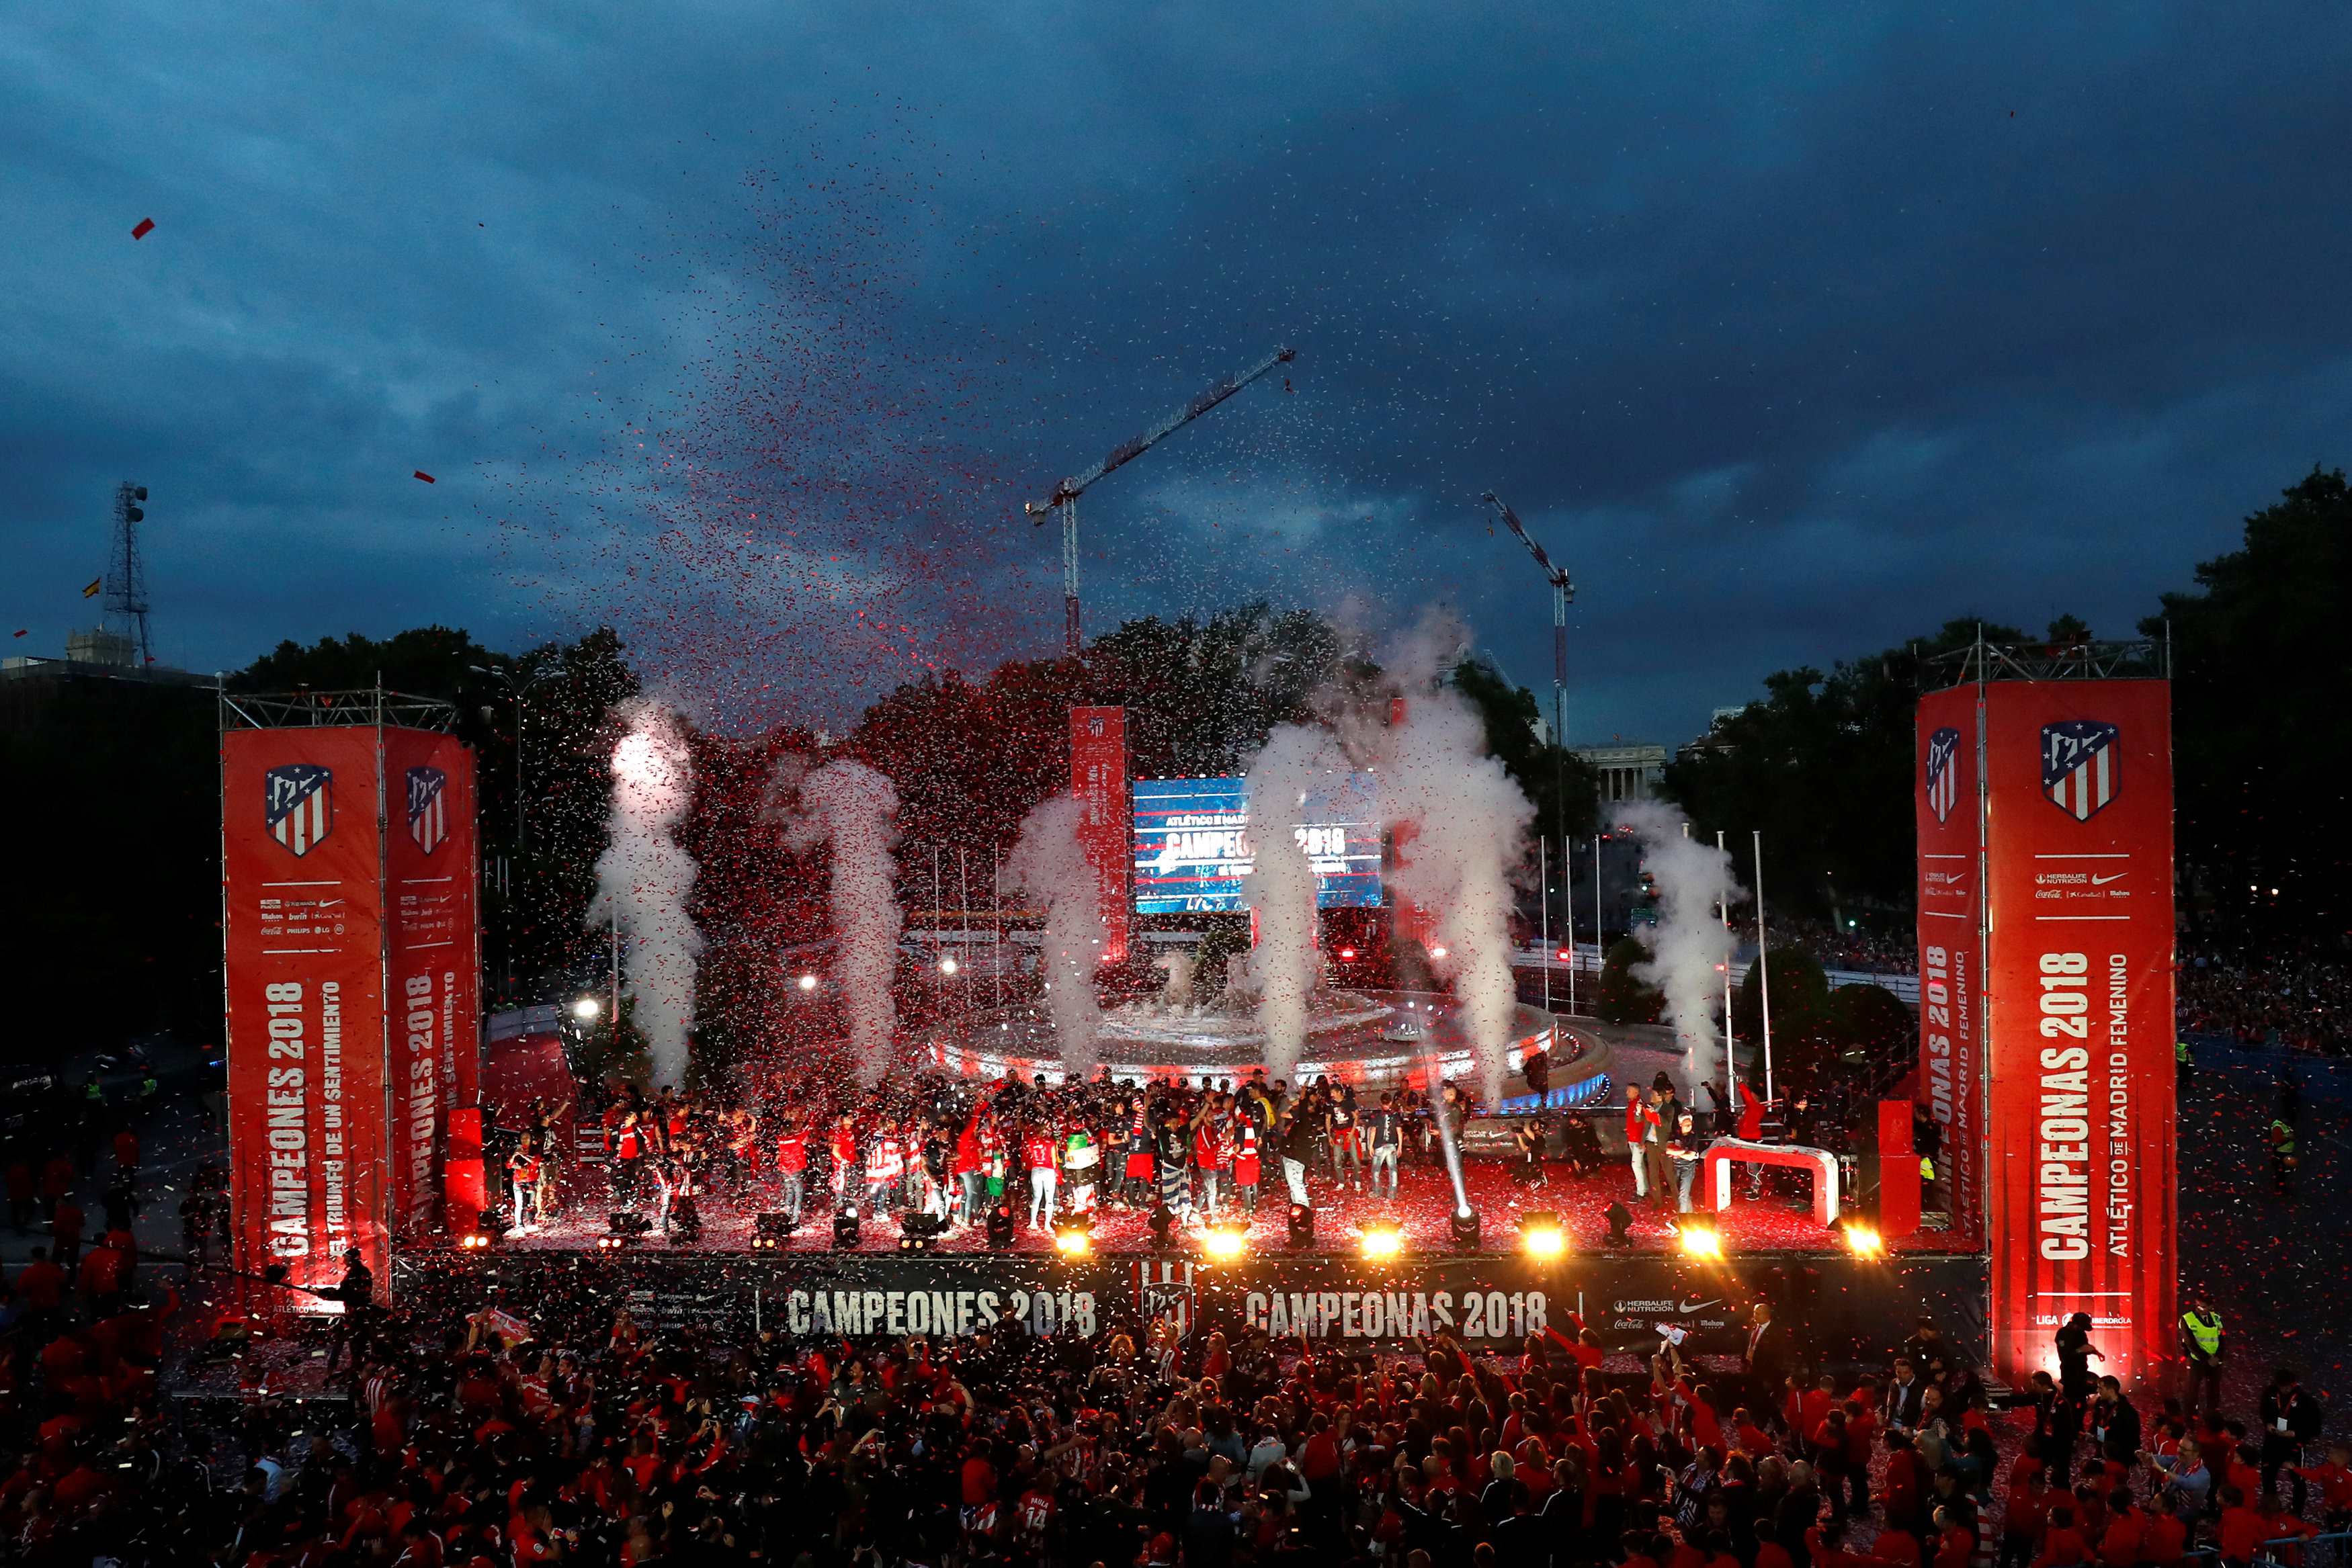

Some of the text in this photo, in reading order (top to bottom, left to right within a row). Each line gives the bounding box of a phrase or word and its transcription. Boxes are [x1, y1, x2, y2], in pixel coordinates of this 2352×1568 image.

[1166, 831, 1255, 859] CAMPEO
[289, 912, 307, 920] bwin
[406, 974, 434, 1054] 2018
[1927, 945, 1949, 1029] 2018
[1955, 951, 1968, 1040] FEMENINO
[442, 971, 456, 1084] SENTIMIENTO
[265, 982, 309, 1257] CAMPEONES 2018
[323, 981, 347, 1256] EL TRIUNFO DE UN SENTIMIENTO
[1958, 1047, 1968, 1129] MADRID
[2039, 952, 2089, 1260] CAMPEONAS 2018
[2107, 953, 2128, 1258] ATLÉTICO DE MADRID FEMENINO
[274, 1305, 309, 1314] ATLÉTICO
[788, 1290, 1096, 1336] CAMPEONES 2018
[1246, 1291, 1547, 1338] CAMPEONAS 2018
[2036, 1315, 2058, 1325] LIGA
[1025, 1506, 1047, 1530] 14
[1031, 1497, 1049, 1509] PAULA
